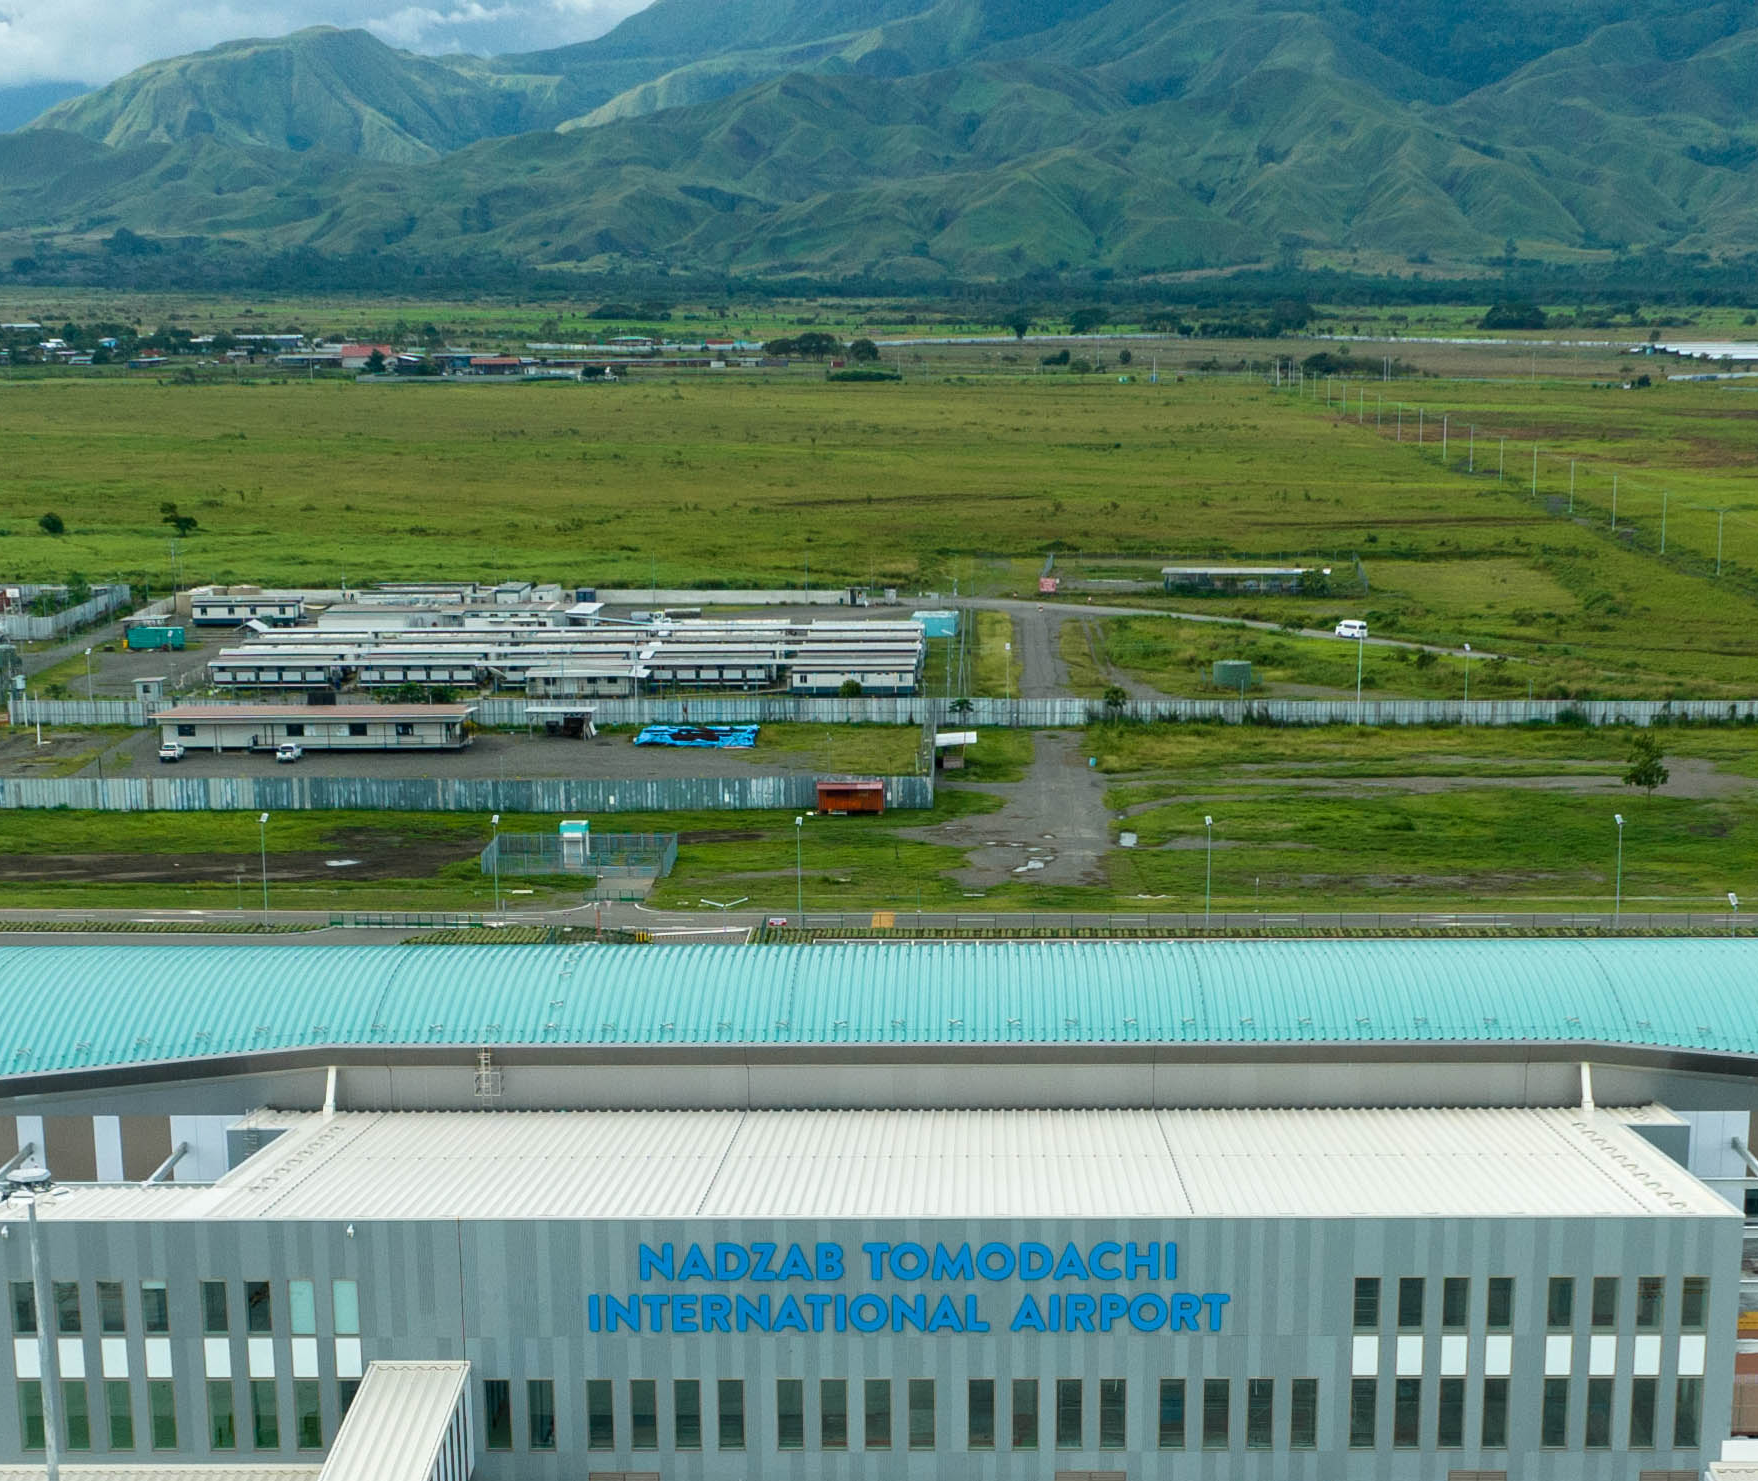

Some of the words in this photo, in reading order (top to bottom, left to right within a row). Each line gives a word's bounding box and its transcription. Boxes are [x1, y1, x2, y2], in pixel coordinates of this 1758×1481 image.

[638, 1242, 845, 1281] NADZAB
[863, 1242, 1178, 1281] TOMODACHI
[588, 1293, 990, 1333] INTERNATIONAL
[1010, 1293, 1230, 1332] AIRPORT
